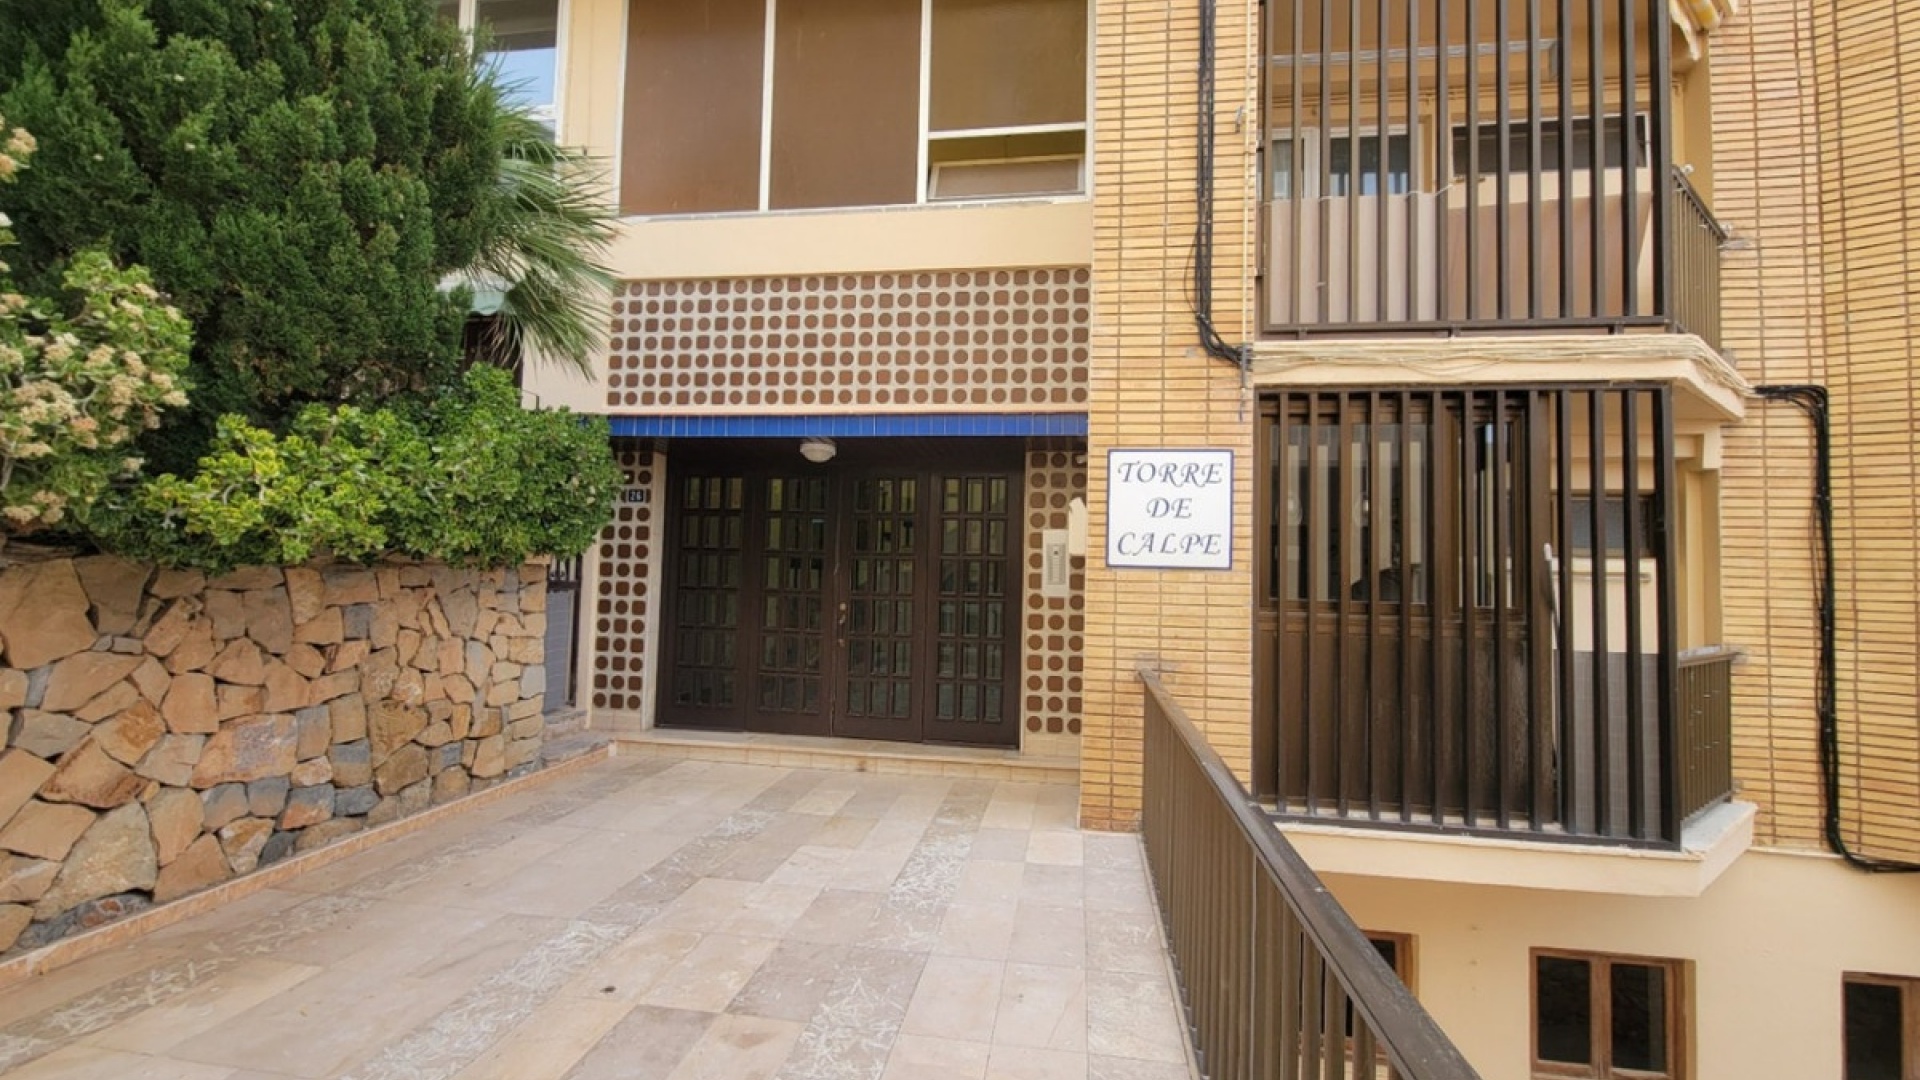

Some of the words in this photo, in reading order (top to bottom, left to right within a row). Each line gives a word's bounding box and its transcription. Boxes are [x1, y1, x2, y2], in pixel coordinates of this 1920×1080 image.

[1117, 460, 1223, 488] TORRE
[1146, 496, 1193, 519] DE
[1117, 531, 1222, 557] CALPE
